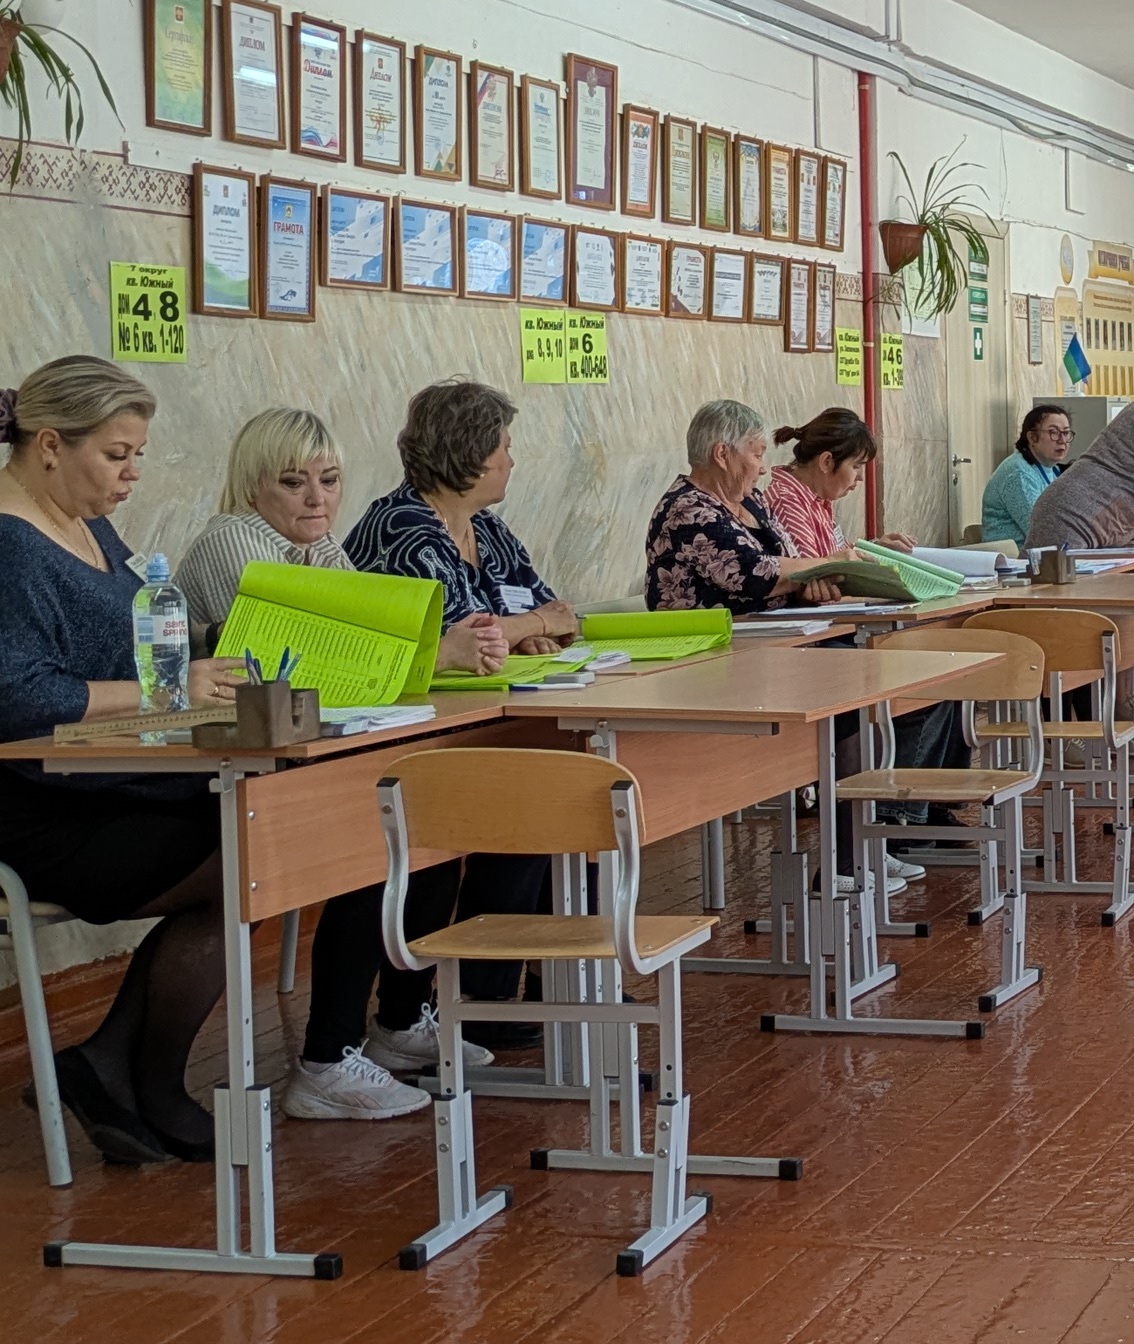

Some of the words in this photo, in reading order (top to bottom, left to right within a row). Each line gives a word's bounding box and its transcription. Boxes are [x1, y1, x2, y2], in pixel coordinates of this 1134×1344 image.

[212, 204, 241, 218] ДИПЛОМ
[273, 221, 305, 235] ГРАМОТА
[130, 264, 137, 272] 7
[138, 267, 169, 276] округ
[126, 277, 139, 287] кв.
[140, 275, 174, 290] Южный
[159, 290, 180, 323] 8
[524, 319, 535, 330] кв.
[536, 316, 564, 331] Южный
[568, 318, 578, 329] кв.
[579, 316, 605, 330] Южный
[118, 321, 131, 352] №
[133, 321, 140, 353] 6
[160, 323, 185, 355] 1-120
[582, 332, 594, 355] 6
[555, 338, 563, 359] 10
[581, 354, 608, 380] 400-648
